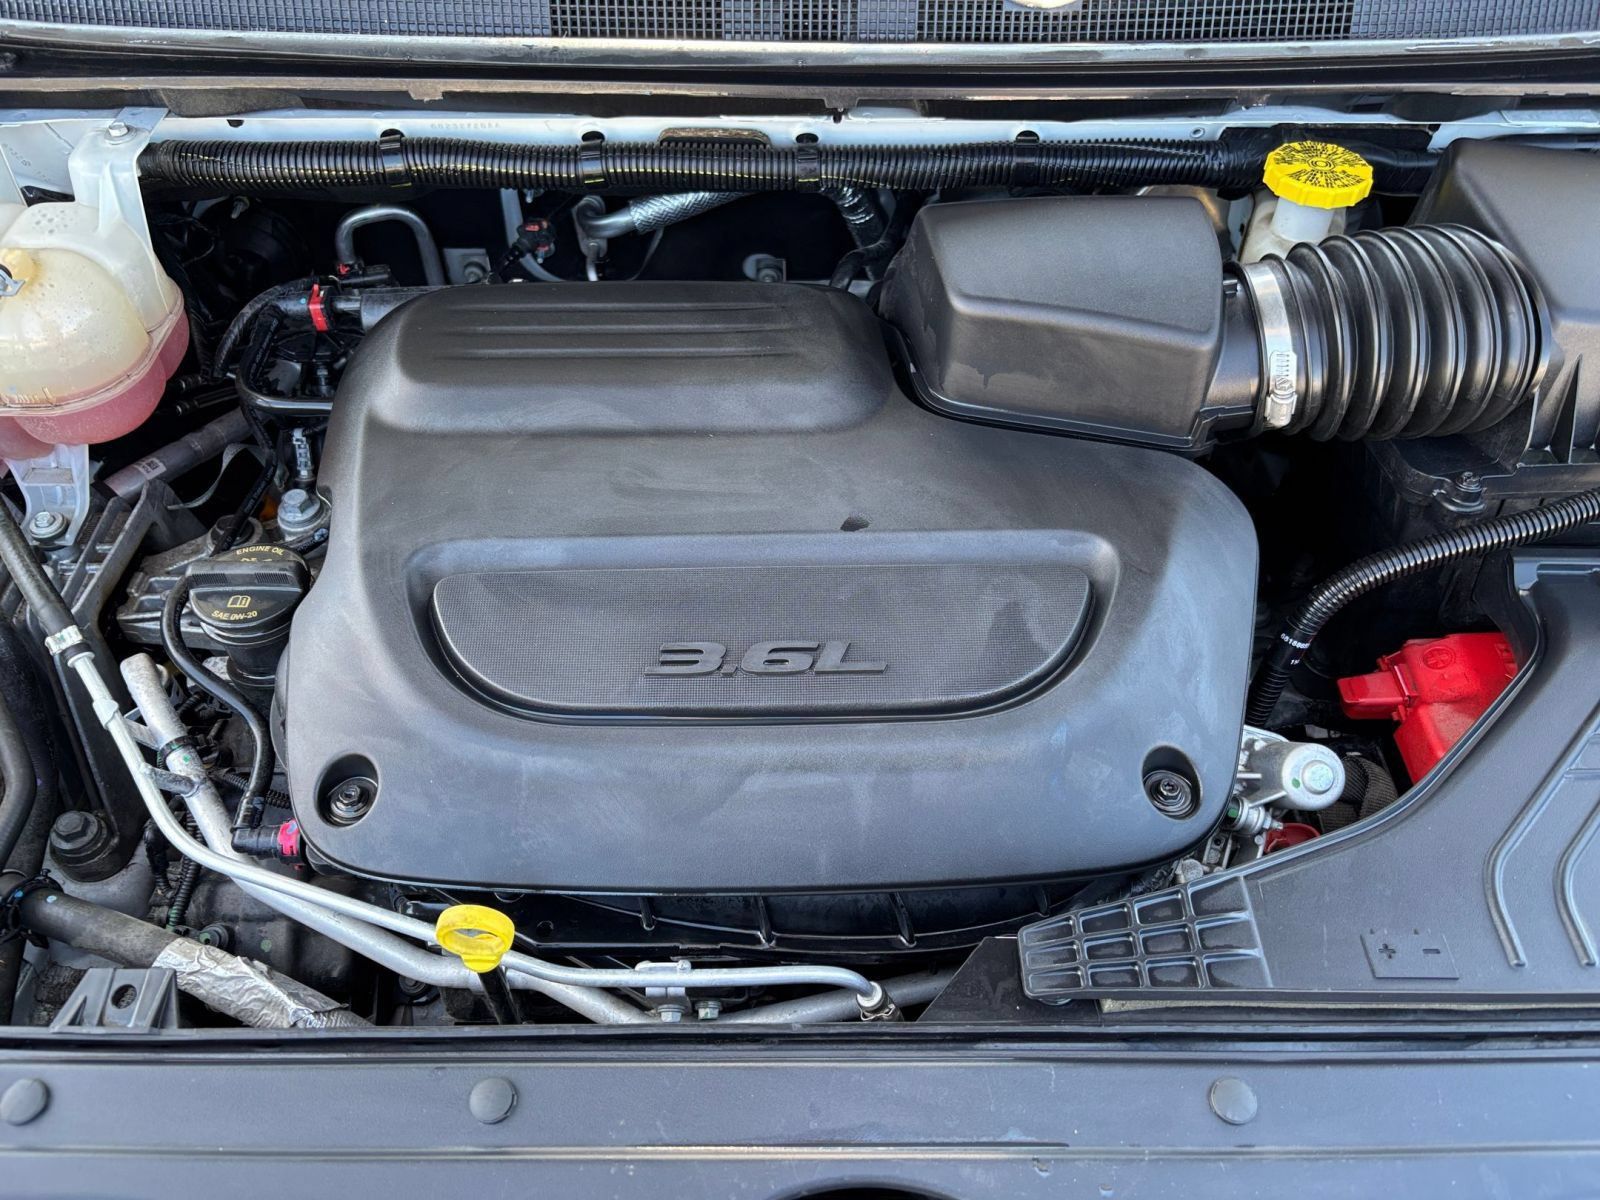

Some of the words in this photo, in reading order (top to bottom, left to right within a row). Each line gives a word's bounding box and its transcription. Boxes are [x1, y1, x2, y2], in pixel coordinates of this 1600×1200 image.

[236, 545, 272, 556] ENGINE
[272, 547, 286, 556] OIL
[211, 610, 230, 620] SAE
[230, 610, 258, 621] 0W-20
[644, 641, 888, 678] 3.6L
